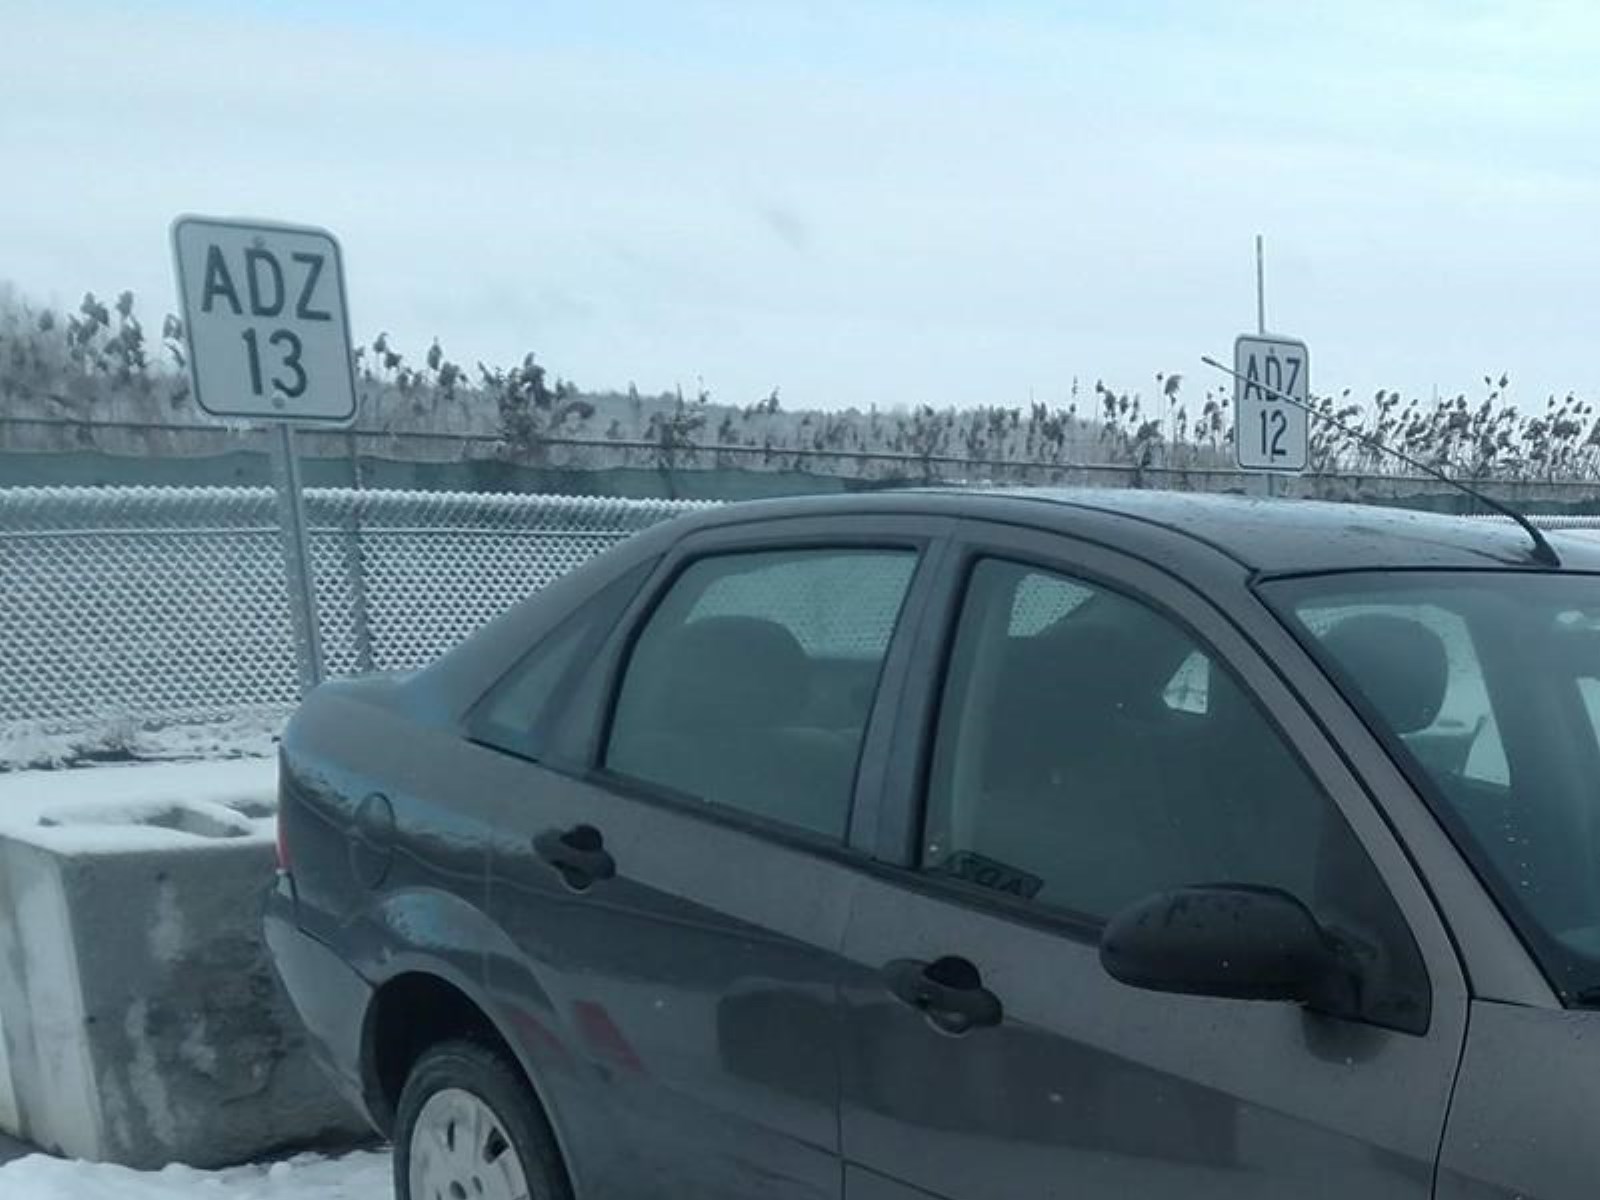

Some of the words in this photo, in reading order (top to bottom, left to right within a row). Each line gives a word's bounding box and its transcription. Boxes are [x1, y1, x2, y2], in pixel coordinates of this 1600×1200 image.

[201, 244, 332, 321] ADZ
[242, 327, 308, 398] 13
[1244, 353, 1302, 401] ADZ
[1260, 409, 1287, 456] 12
